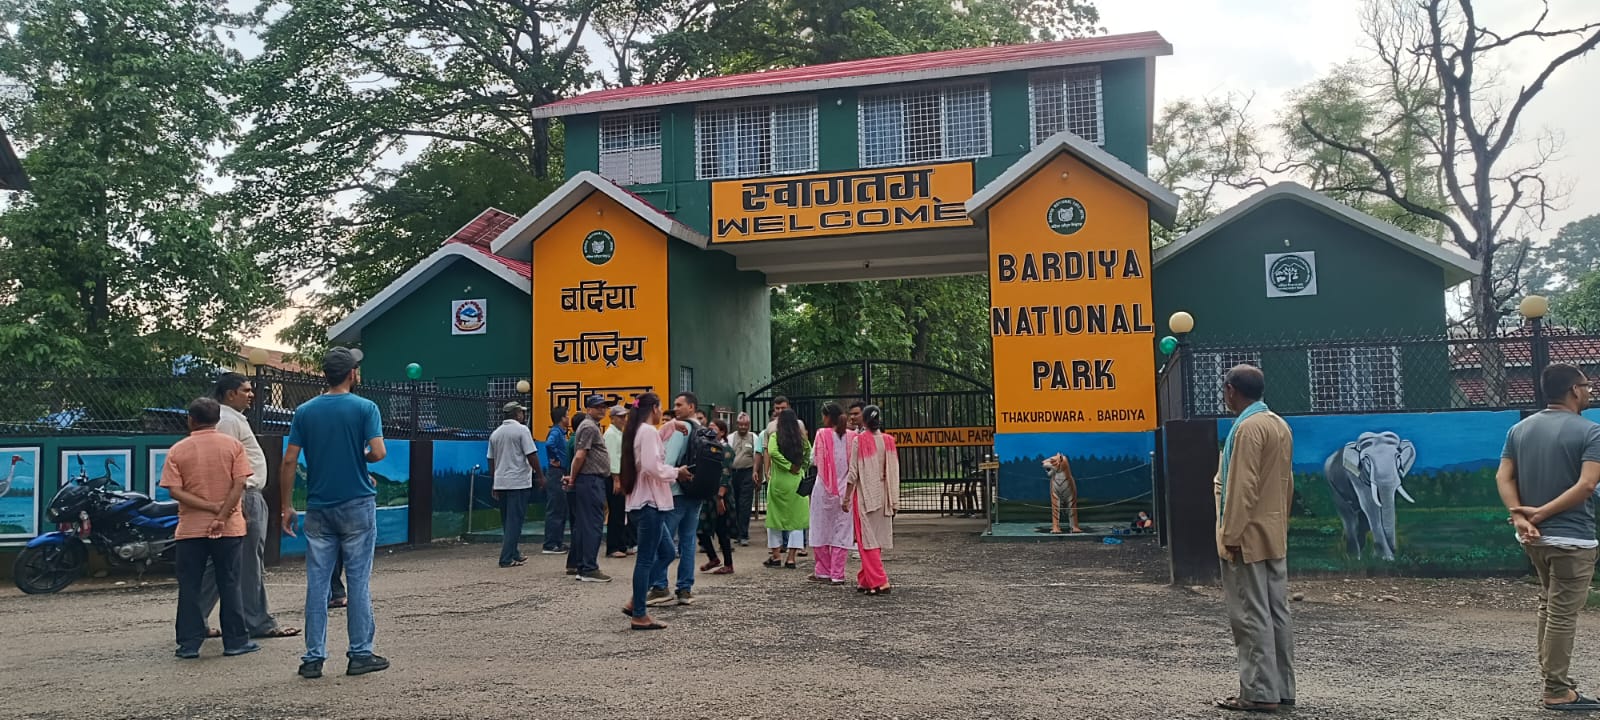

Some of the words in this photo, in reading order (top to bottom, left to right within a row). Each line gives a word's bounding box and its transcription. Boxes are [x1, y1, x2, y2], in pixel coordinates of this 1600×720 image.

[717, 203, 968, 237] WELCOME
[998, 249, 1143, 282] BARDIYA
[561, 280, 637, 312] बर्दिया
[991, 303, 1154, 336] NATIONAL
[1032, 359, 1116, 391] PARK
[1001, 410, 1084, 423] THAKURDWARA
[1097, 409, 1145, 422] BARDIYA
[915, 430, 965, 444] NATIONAL
